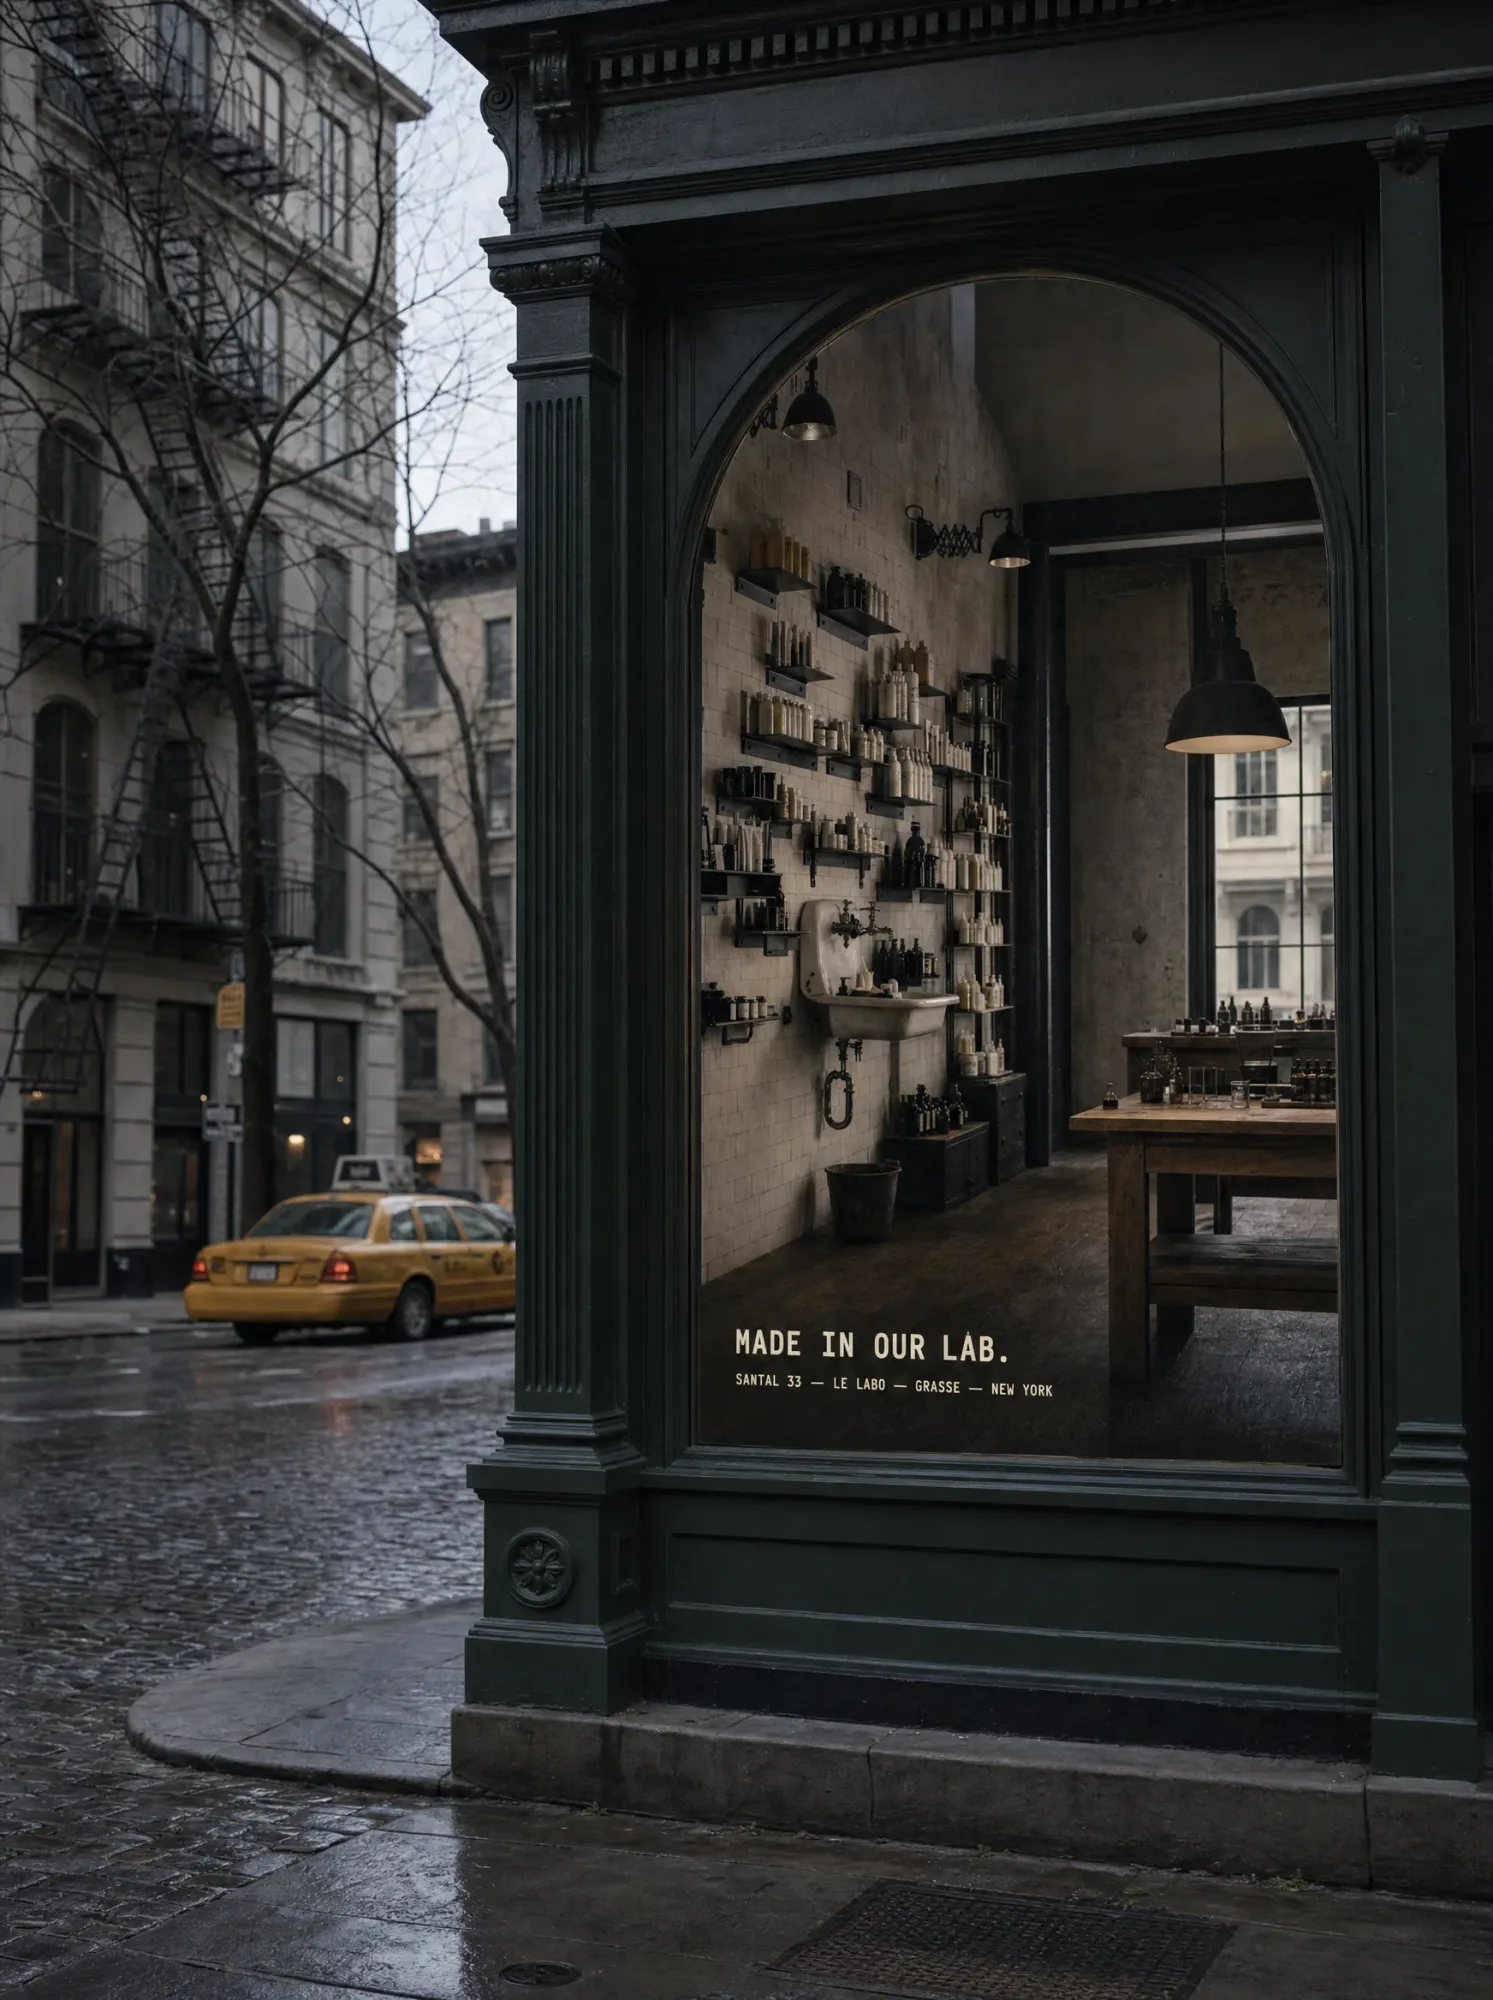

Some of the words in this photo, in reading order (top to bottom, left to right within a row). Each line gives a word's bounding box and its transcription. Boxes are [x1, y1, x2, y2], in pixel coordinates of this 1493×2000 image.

[735, 1328, 801, 1357] MADE
[822, 1330, 854, 1358] IN
[874, 1332, 926, 1361] OUR
[943, 1334, 1008, 1363] LAB.
[735, 1372, 780, 1387] SANTAL
[787, 1374, 802, 1388] 33
[833, 1376, 848, 1390] LE
[856, 1377, 886, 1391] LABO
[915, 1379, 961, 1394] GRASSE
[991, 1382, 1015, 1396] NEW
[1022, 1383, 1053, 1397] YORK
